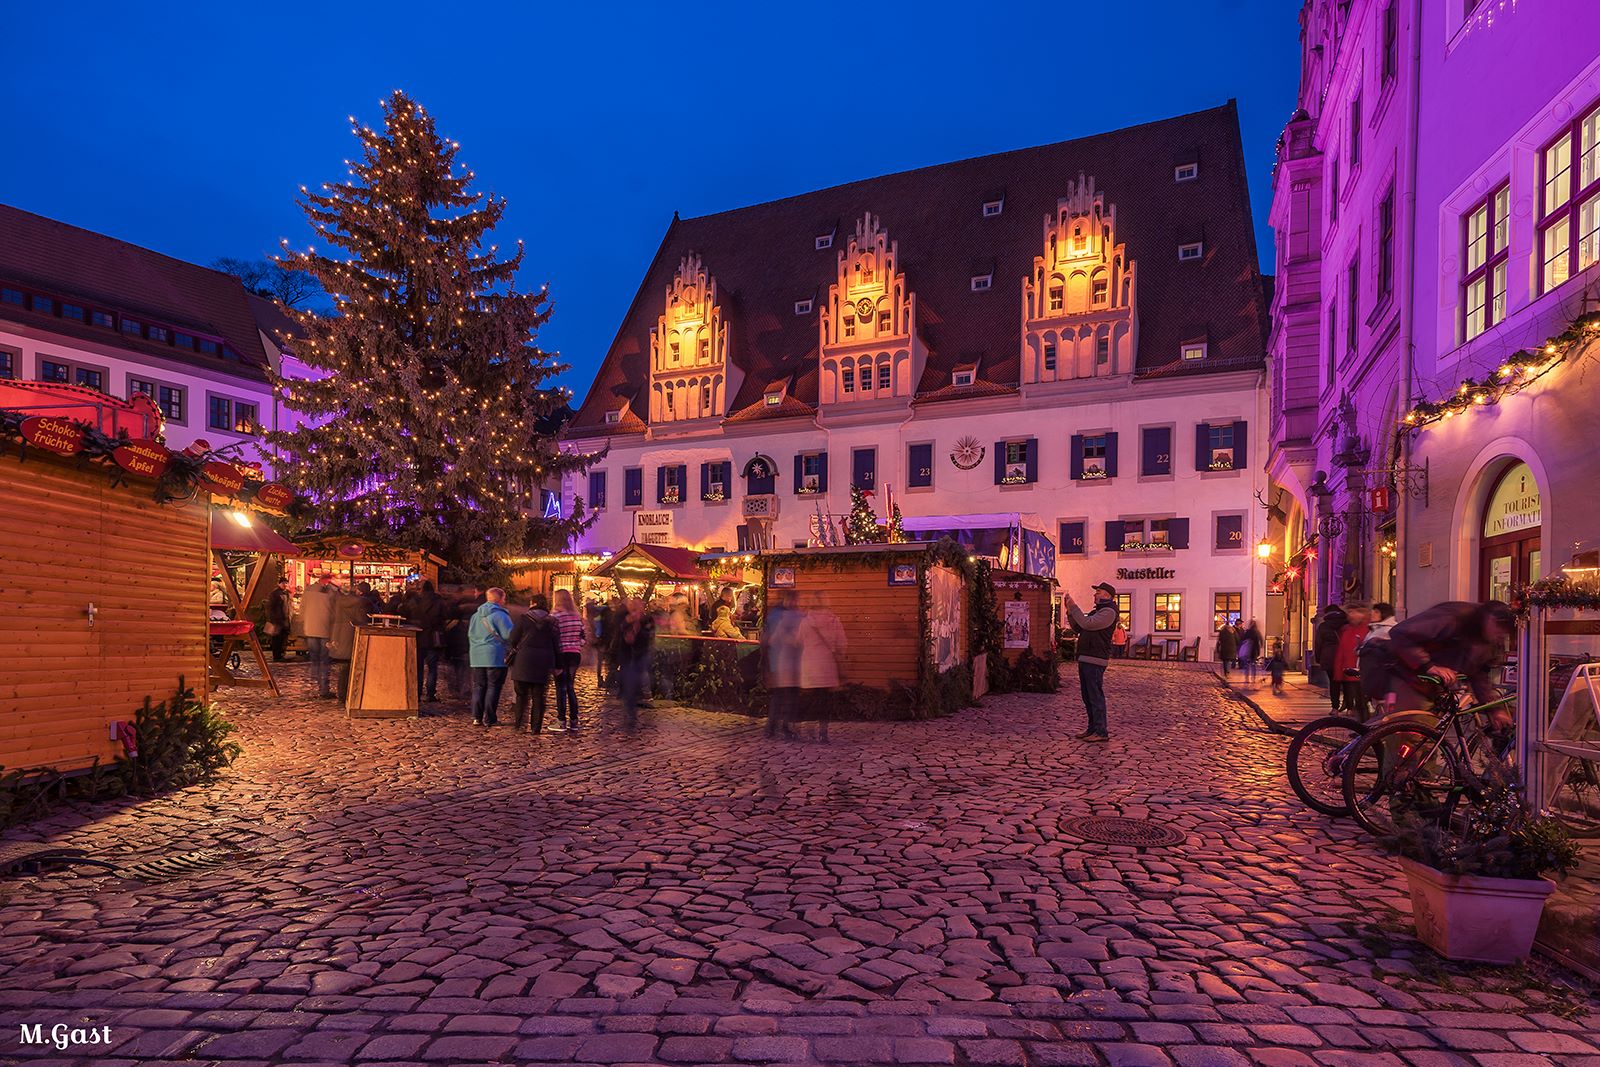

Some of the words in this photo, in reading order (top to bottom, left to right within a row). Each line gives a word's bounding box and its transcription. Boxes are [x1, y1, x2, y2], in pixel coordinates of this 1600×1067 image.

[38, 418, 81, 438] Schoko-
[34, 431, 75, 452] früchte
[128, 455, 154, 474] Äpfel
[1156, 454, 1169, 464] 22
[864, 471, 873, 480] 21
[920, 467, 931, 476] 23
[1503, 494, 1541, 515] TOURIST
[1072, 537, 1083, 546] 16
[1229, 531, 1242, 541] 20
[1116, 567, 1176, 581] Ratskeller
